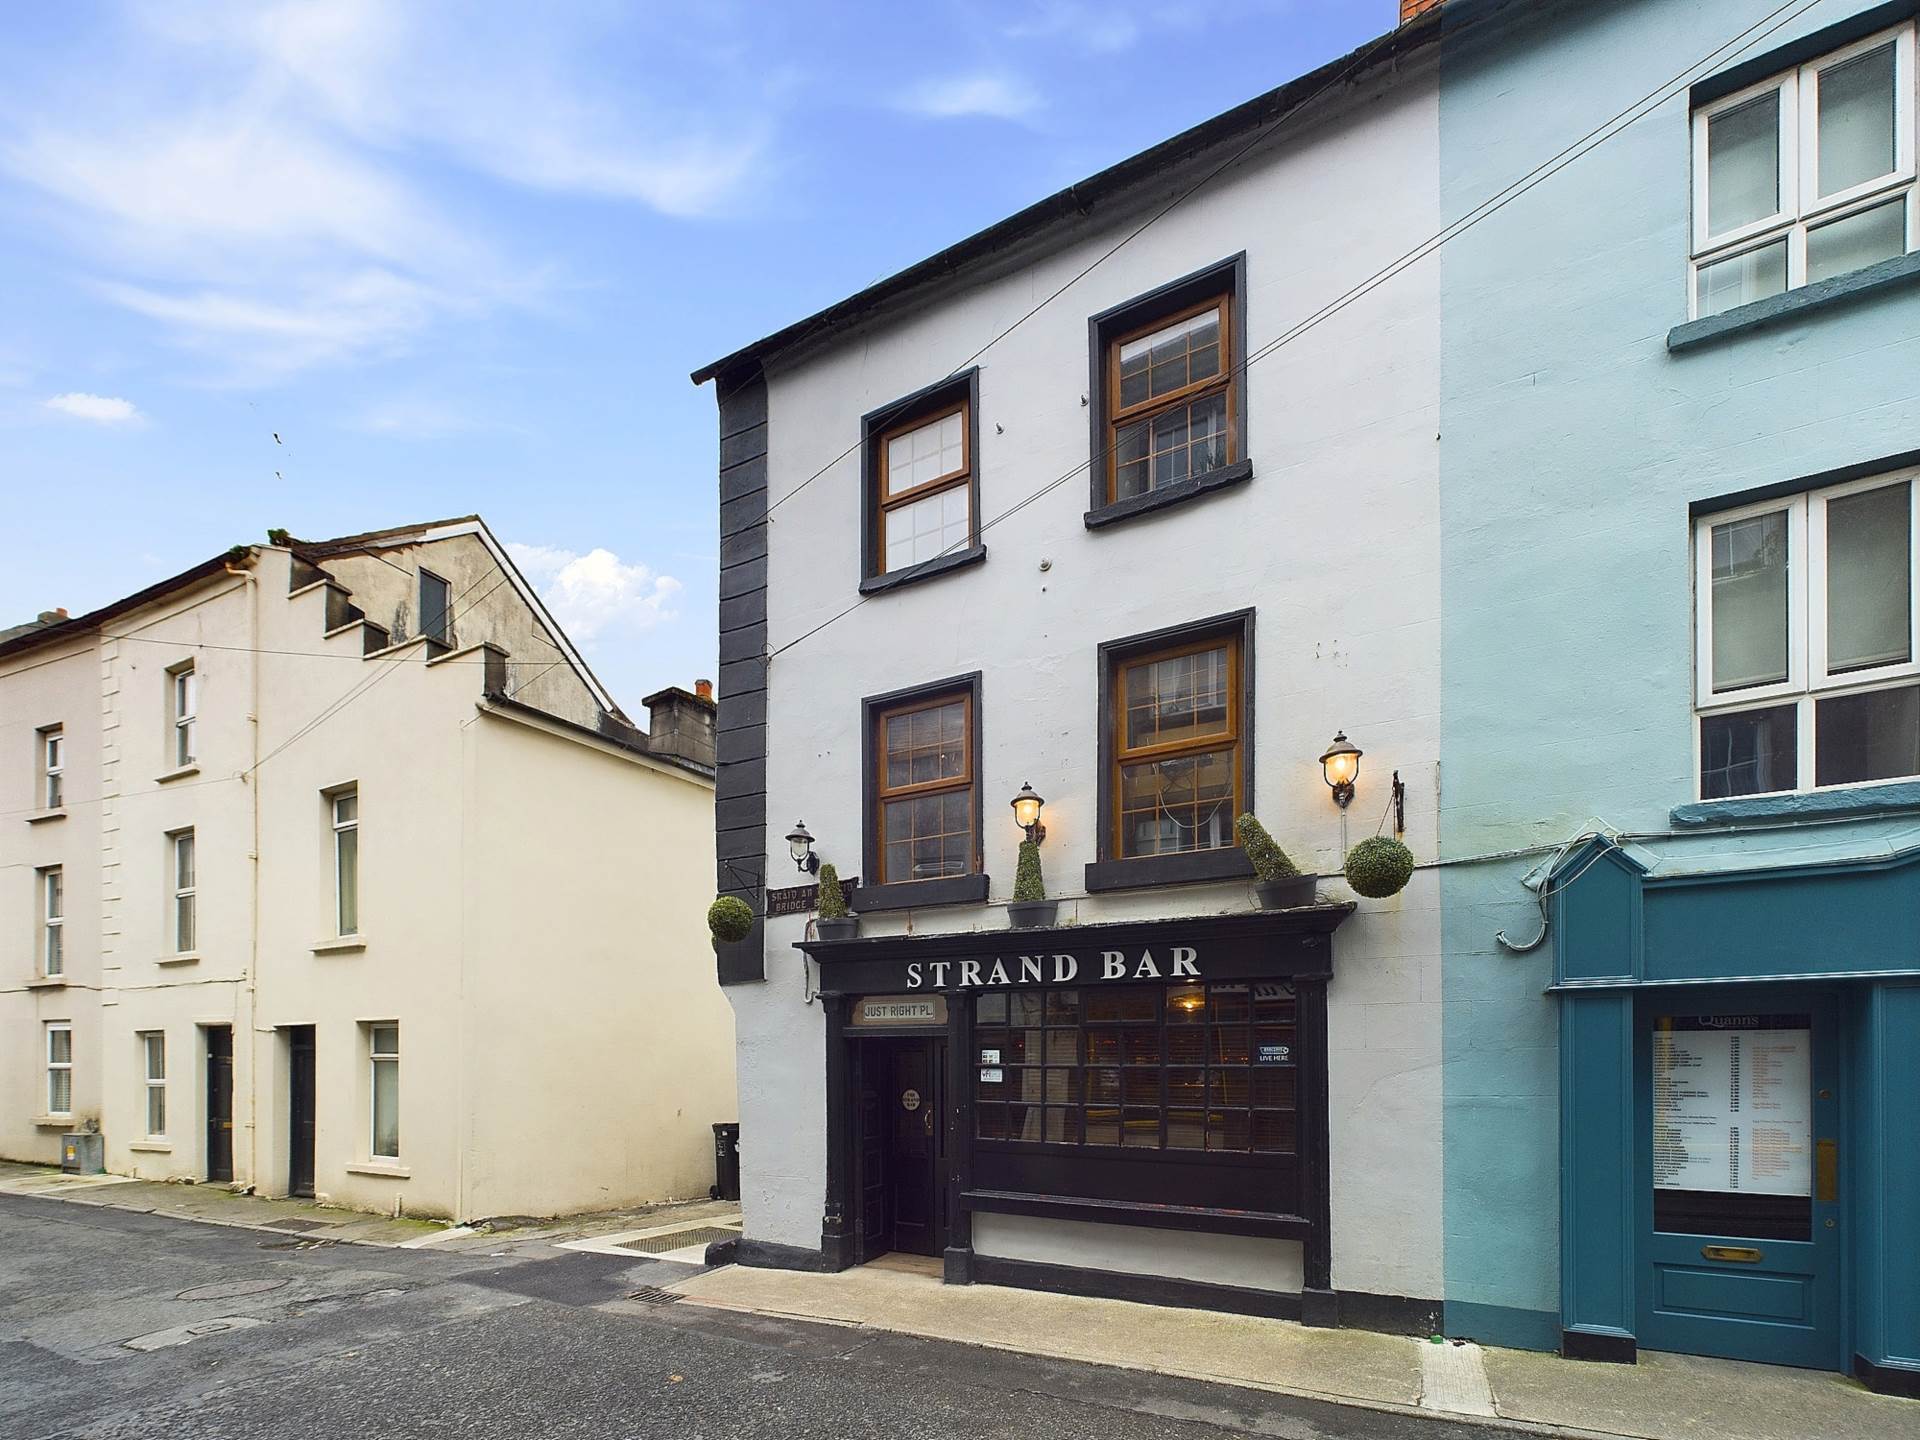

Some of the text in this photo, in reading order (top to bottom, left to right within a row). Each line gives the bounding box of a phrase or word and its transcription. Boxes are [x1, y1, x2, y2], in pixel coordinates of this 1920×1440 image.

[776, 900, 807, 912] BRIDGE
[906, 946, 1202, 989] STRAND BAR
[865, 1006, 886, 1017] JUST
[890, 1004, 917, 1017] RIGHT
